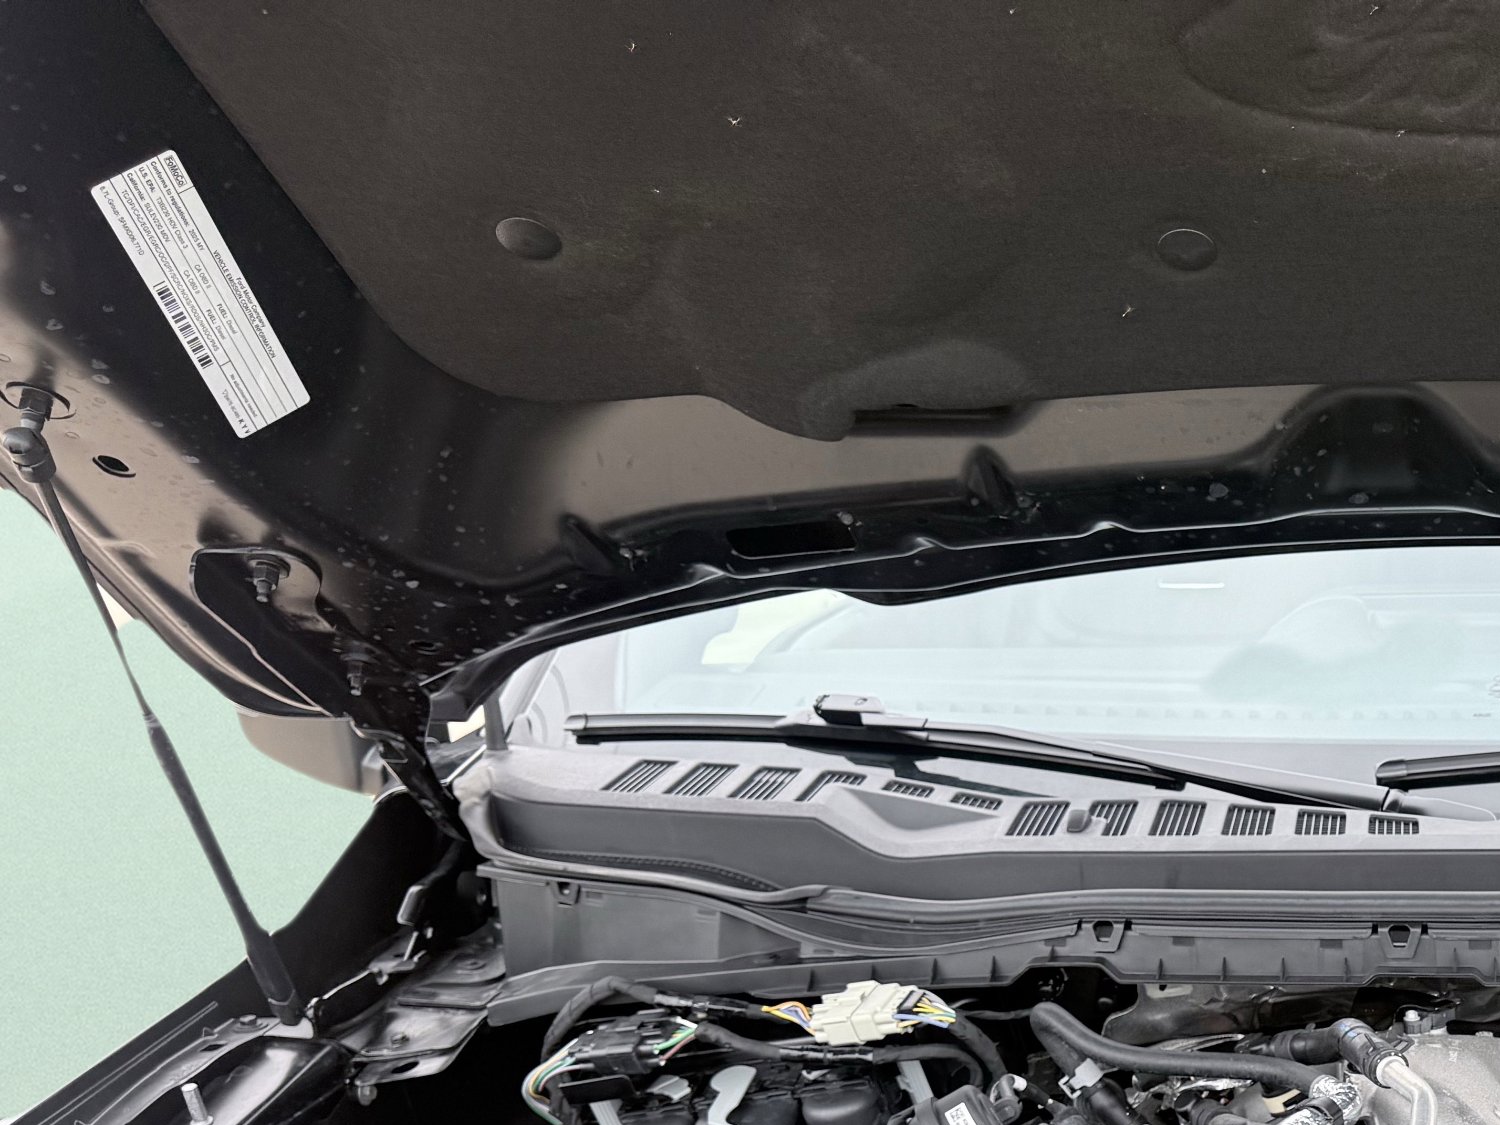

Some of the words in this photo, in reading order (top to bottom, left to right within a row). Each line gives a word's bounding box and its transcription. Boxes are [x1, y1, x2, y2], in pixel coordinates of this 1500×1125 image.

[149, 160, 168, 188] Conforms
[164, 155, 186, 186] FoMoCo
[165, 188, 172, 196] to
[167, 195, 190, 228] regulations:
[125, 172, 146, 201] California:
[205, 308, 217, 324] FUEL:
[137, 166, 148, 179] U.S.
[145, 179, 156, 193] EPA:
[216, 303, 228, 319] FUEL:
[212, 249, 229, 273] VEHICLE
[225, 272, 243, 299] EMISSION
[239, 298, 257, 324] CONTROL
[253, 323, 276, 358] INFORMATION
[235, 276, 245, 289] Ford
[242, 289, 254, 304] Motor
[250, 304, 266, 328] Company
